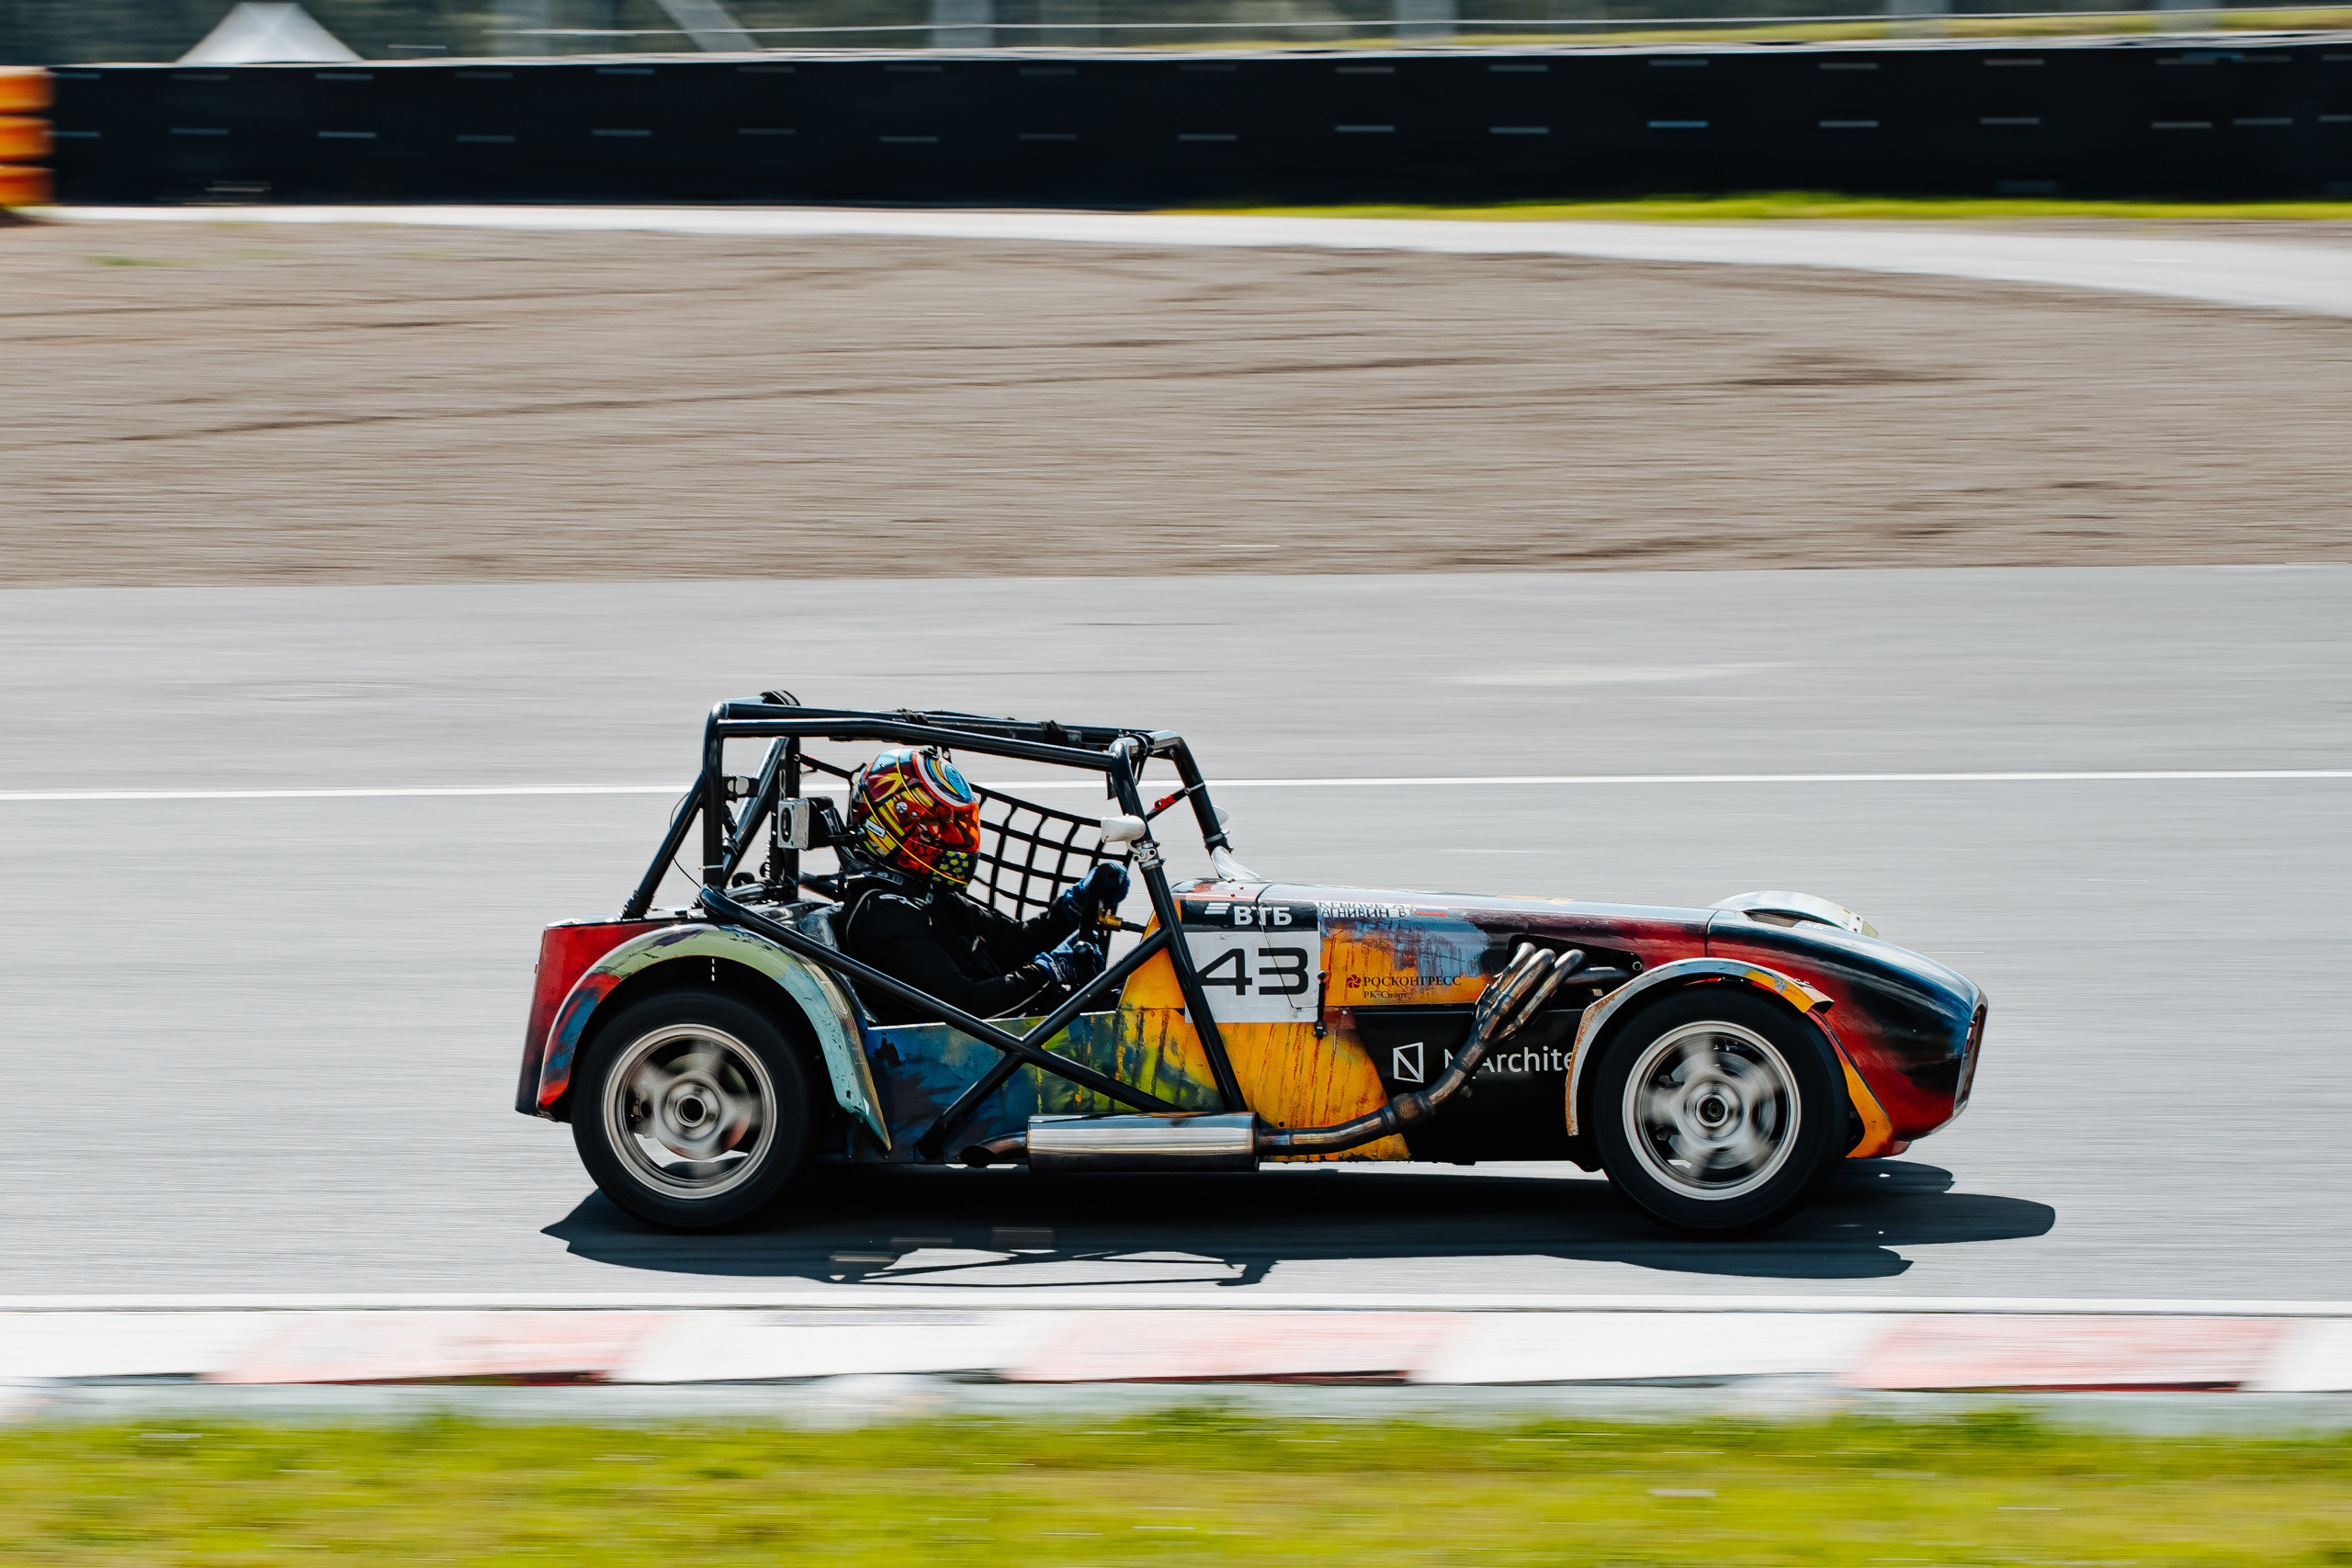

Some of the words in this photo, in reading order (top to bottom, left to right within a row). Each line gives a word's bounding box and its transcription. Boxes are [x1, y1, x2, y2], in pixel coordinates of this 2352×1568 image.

[1233, 906, 1293, 926] ВТБ
[1195, 947, 1309, 996] 43
[1363, 976, 1462, 987] РОСКОНГРЕСС
